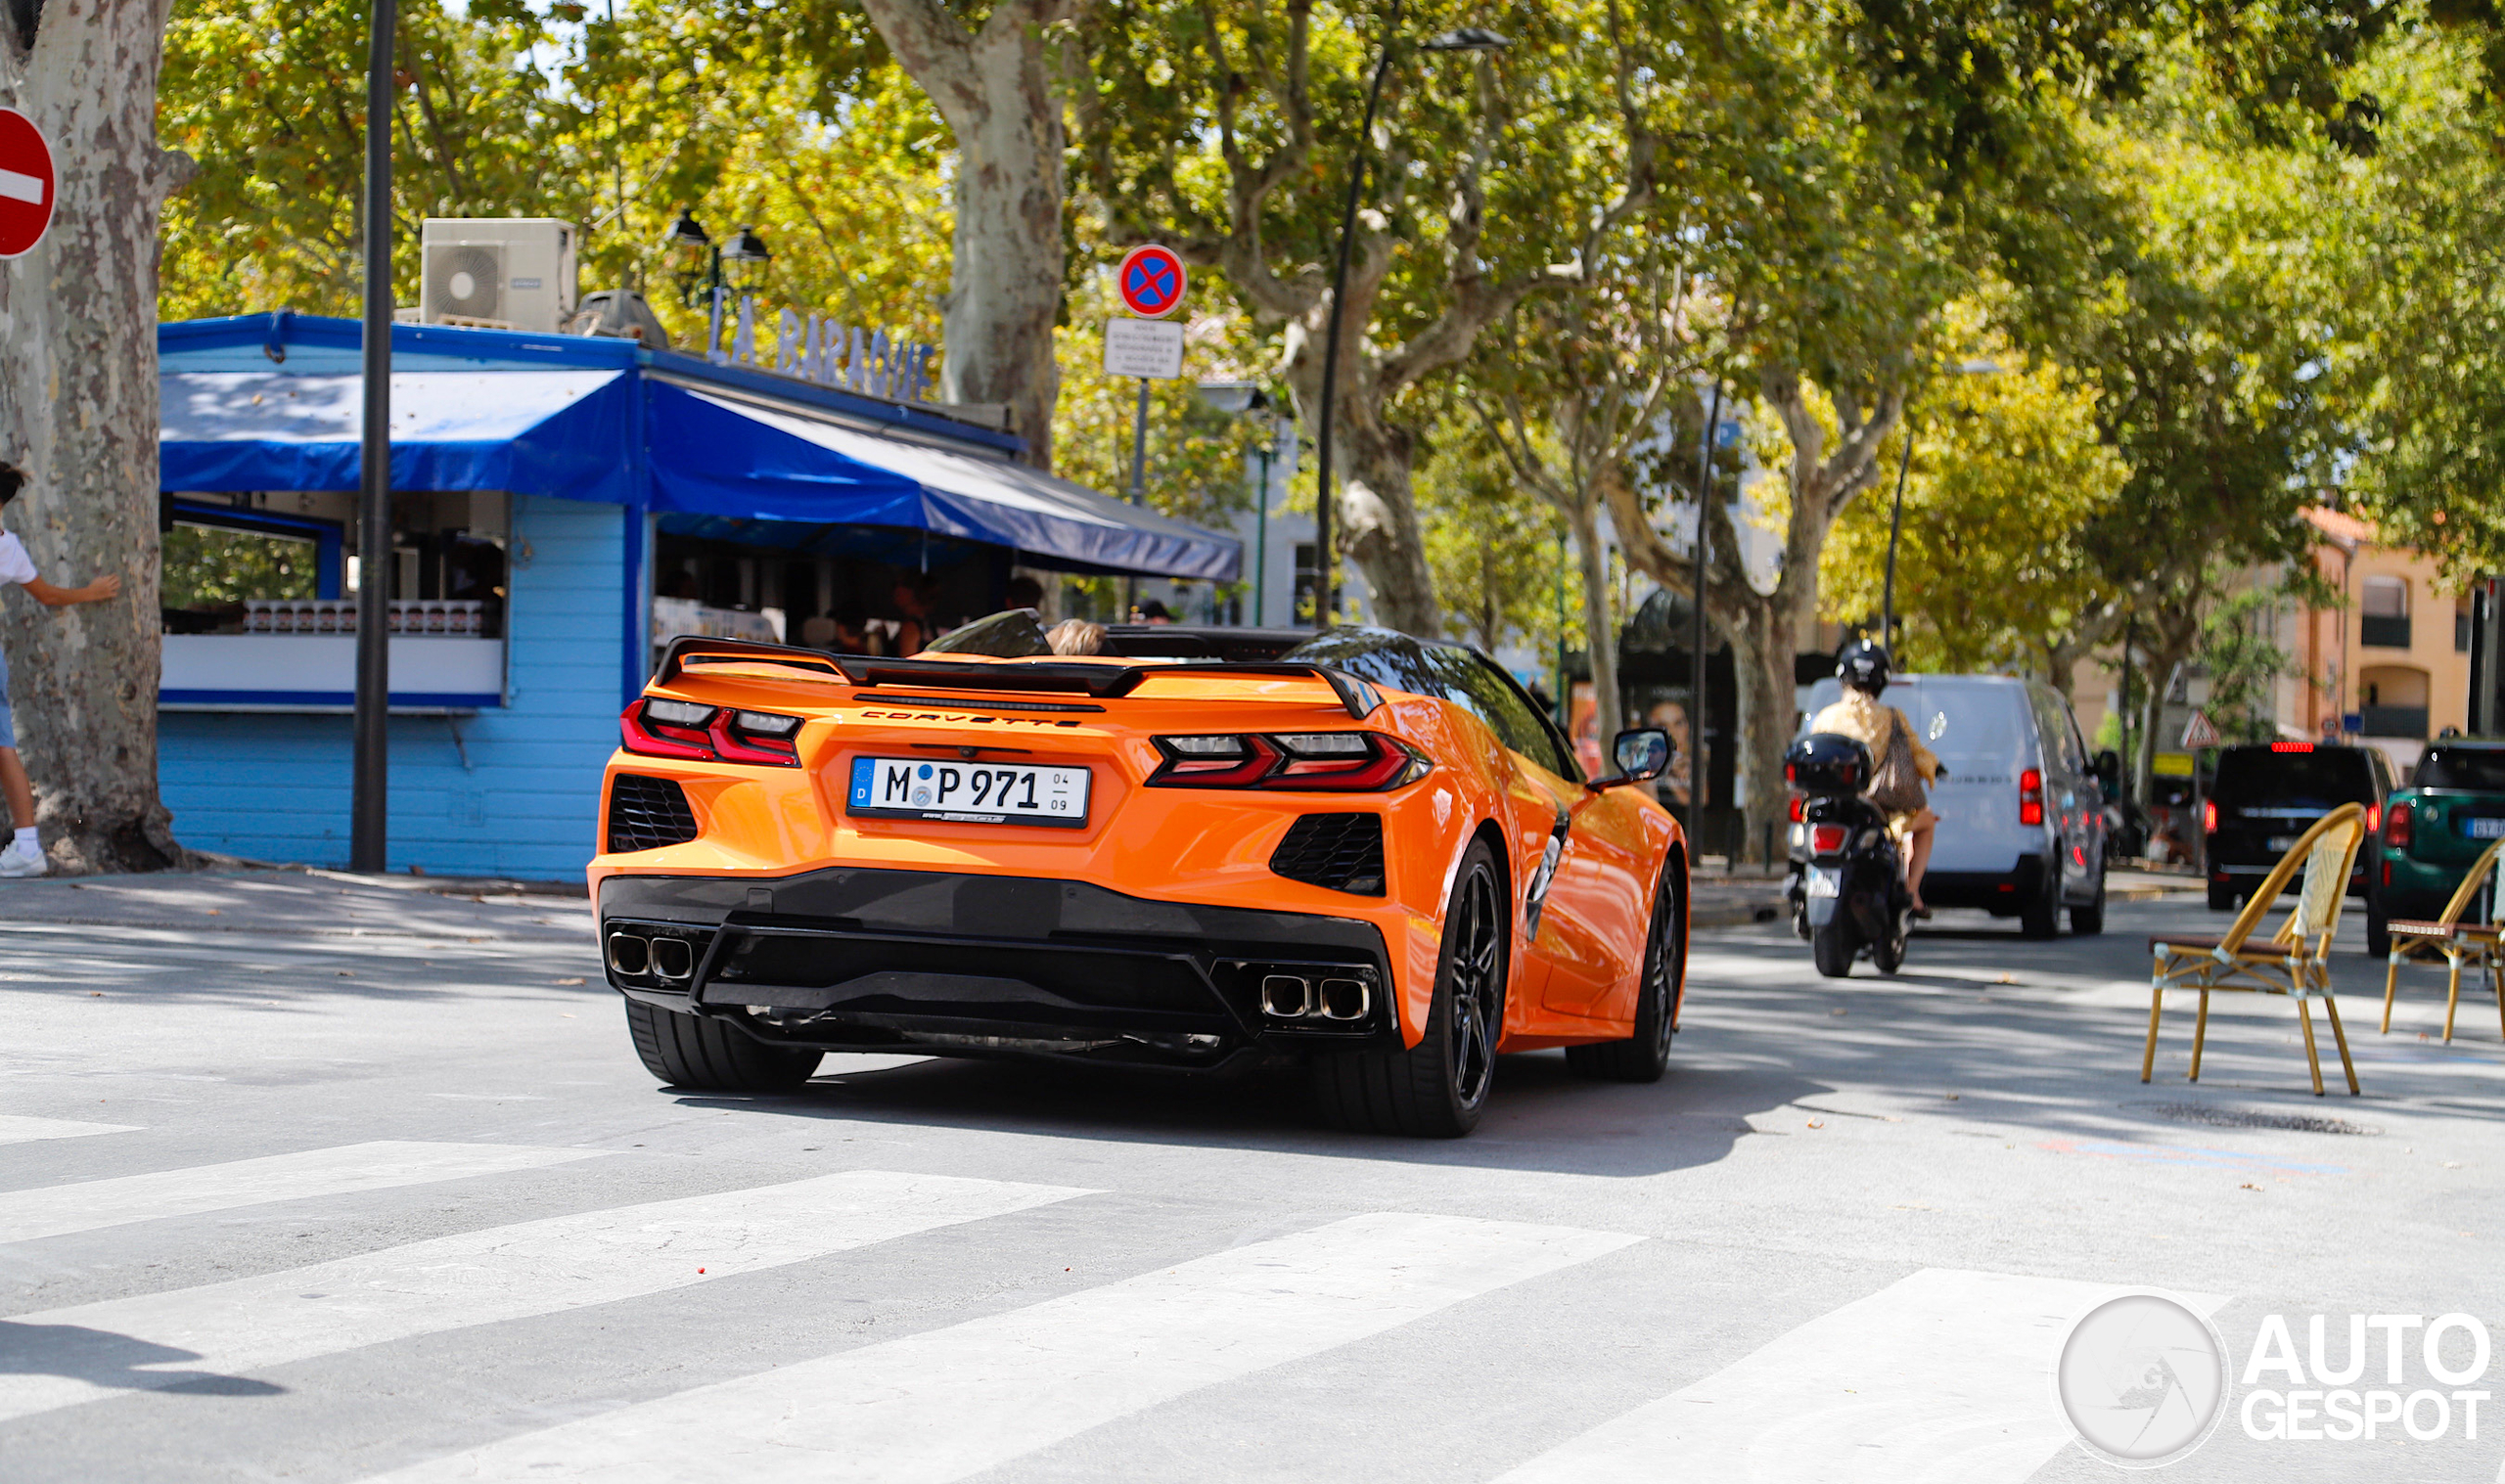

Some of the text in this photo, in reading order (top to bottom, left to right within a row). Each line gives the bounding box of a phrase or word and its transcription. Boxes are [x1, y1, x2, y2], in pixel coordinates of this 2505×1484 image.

[706, 286, 755, 366] LA
[861, 711, 1082, 728] CORVETTE
[1053, 774, 1069, 785] 04
[857, 788, 866, 799] D
[885, 766, 911, 802] M
[971, 770, 1038, 809] 971
[1051, 800, 1067, 811] 09
